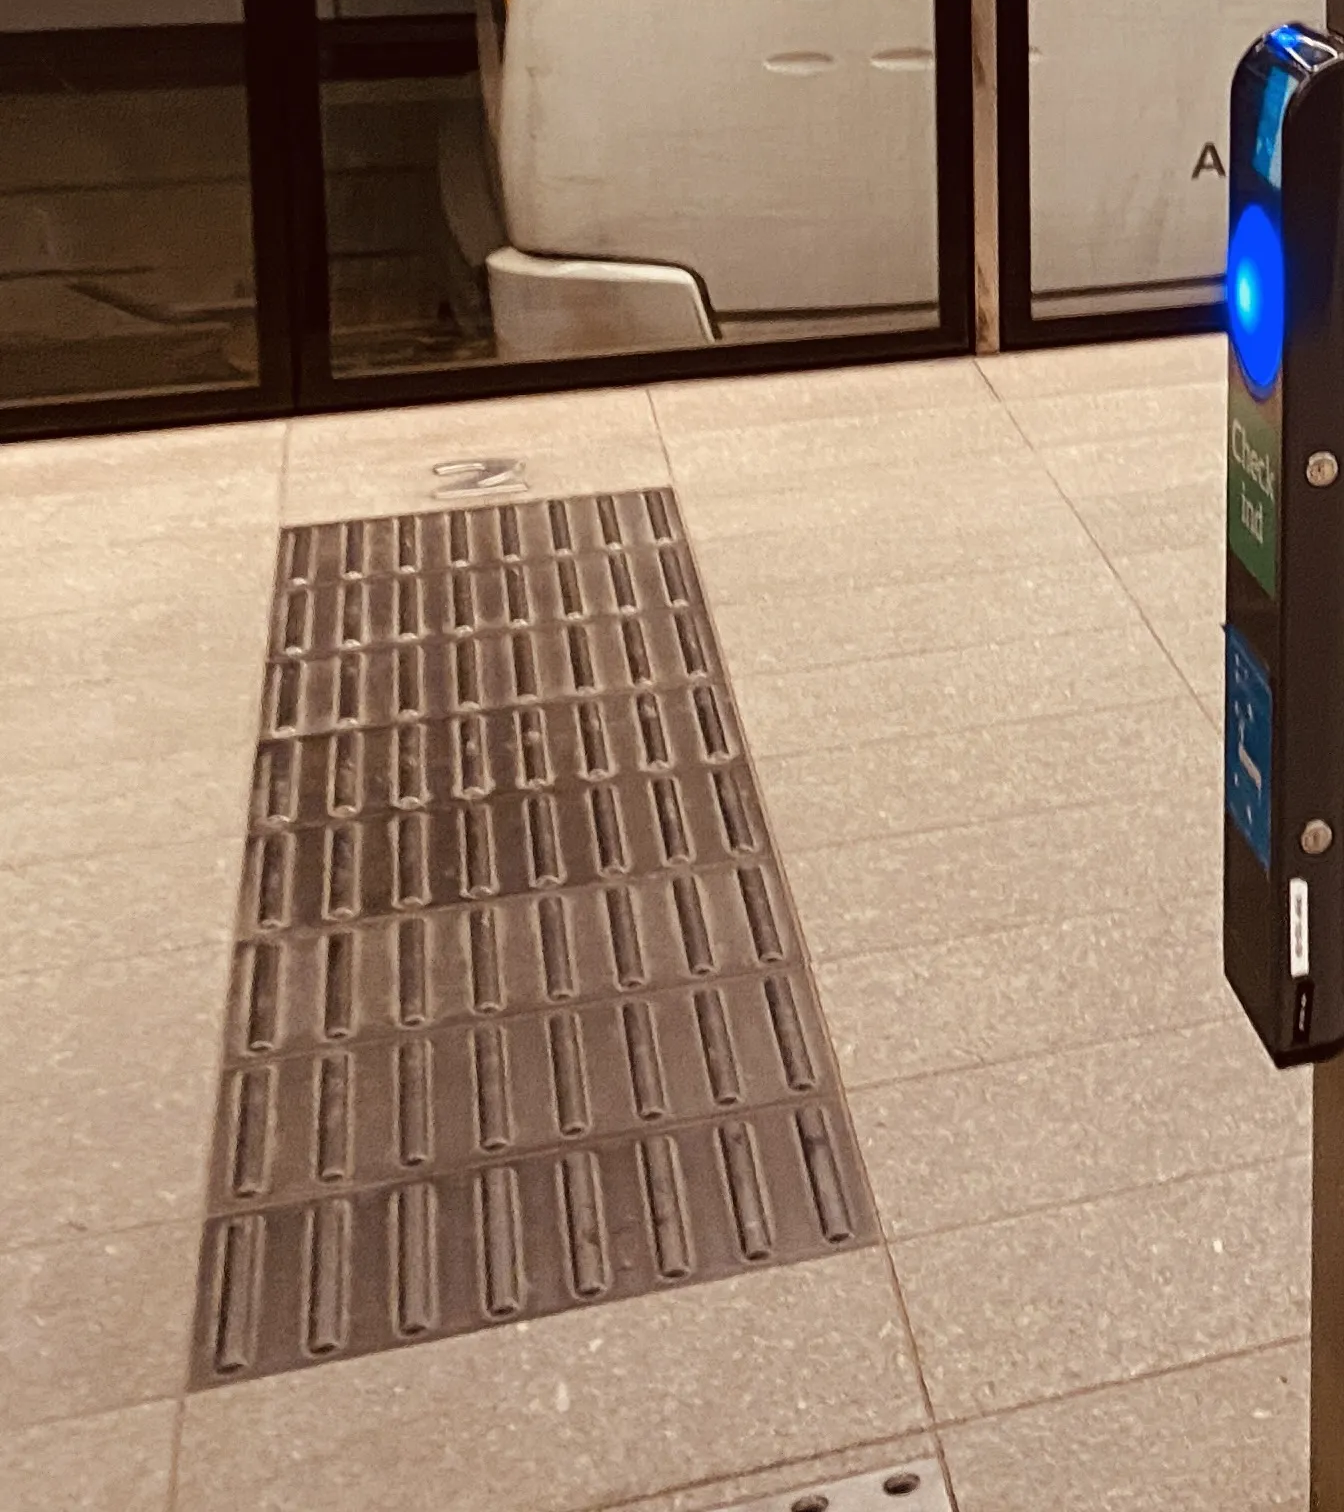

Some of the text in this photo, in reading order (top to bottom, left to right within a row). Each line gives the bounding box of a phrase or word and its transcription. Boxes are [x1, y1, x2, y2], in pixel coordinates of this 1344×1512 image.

[432, 458, 528, 499] 2
[1231, 418, 1275, 505] Check
[1240, 481, 1264, 545] ind
